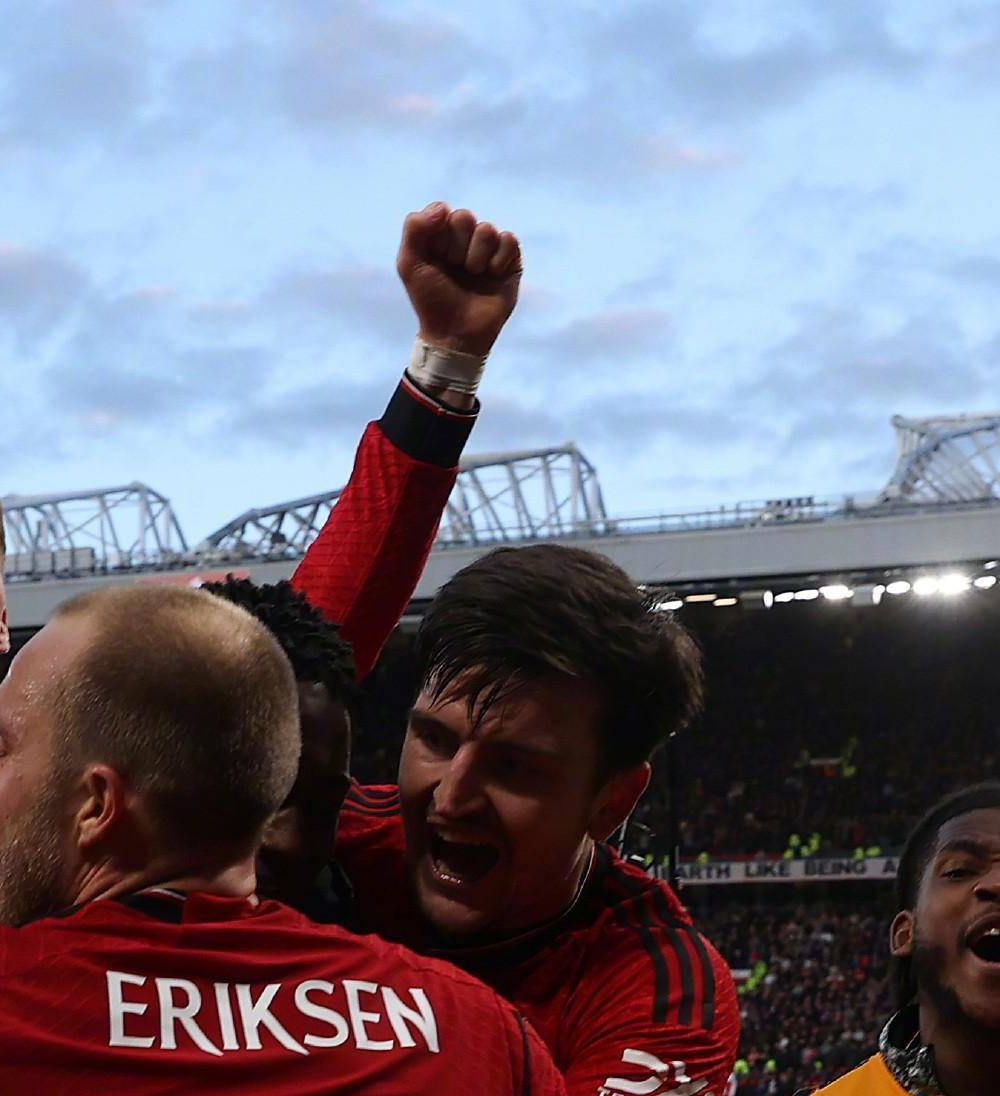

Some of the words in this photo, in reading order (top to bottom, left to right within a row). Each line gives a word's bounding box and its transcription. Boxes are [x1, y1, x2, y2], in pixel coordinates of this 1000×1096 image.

[745, 860, 791, 877] LIKE
[804, 859, 867, 876] BEING
[105, 969, 441, 1058] ERIKSEN
